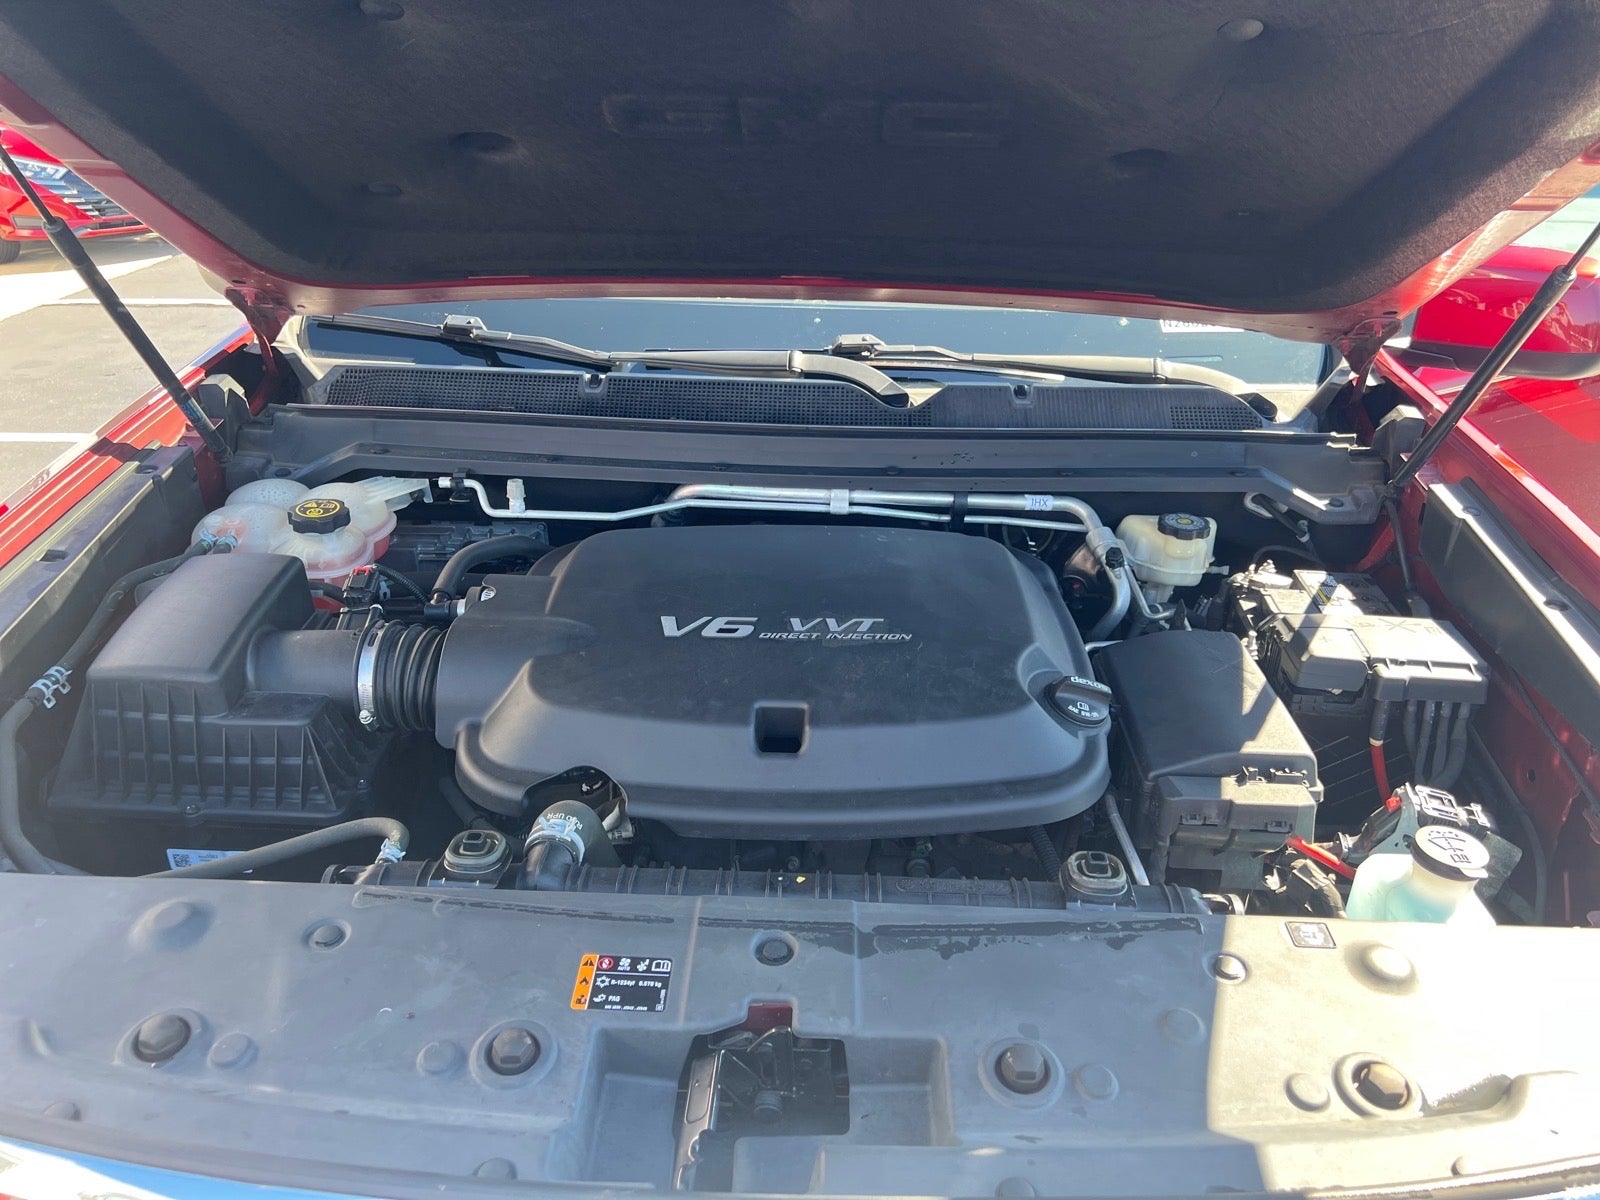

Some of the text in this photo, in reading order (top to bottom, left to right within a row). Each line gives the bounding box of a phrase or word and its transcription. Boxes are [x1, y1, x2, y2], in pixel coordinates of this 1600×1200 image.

[602, 92, 1007, 147] GMC
[661, 616, 884, 637] V6 VVT
[759, 632, 912, 641] DIRECT INJECTION
